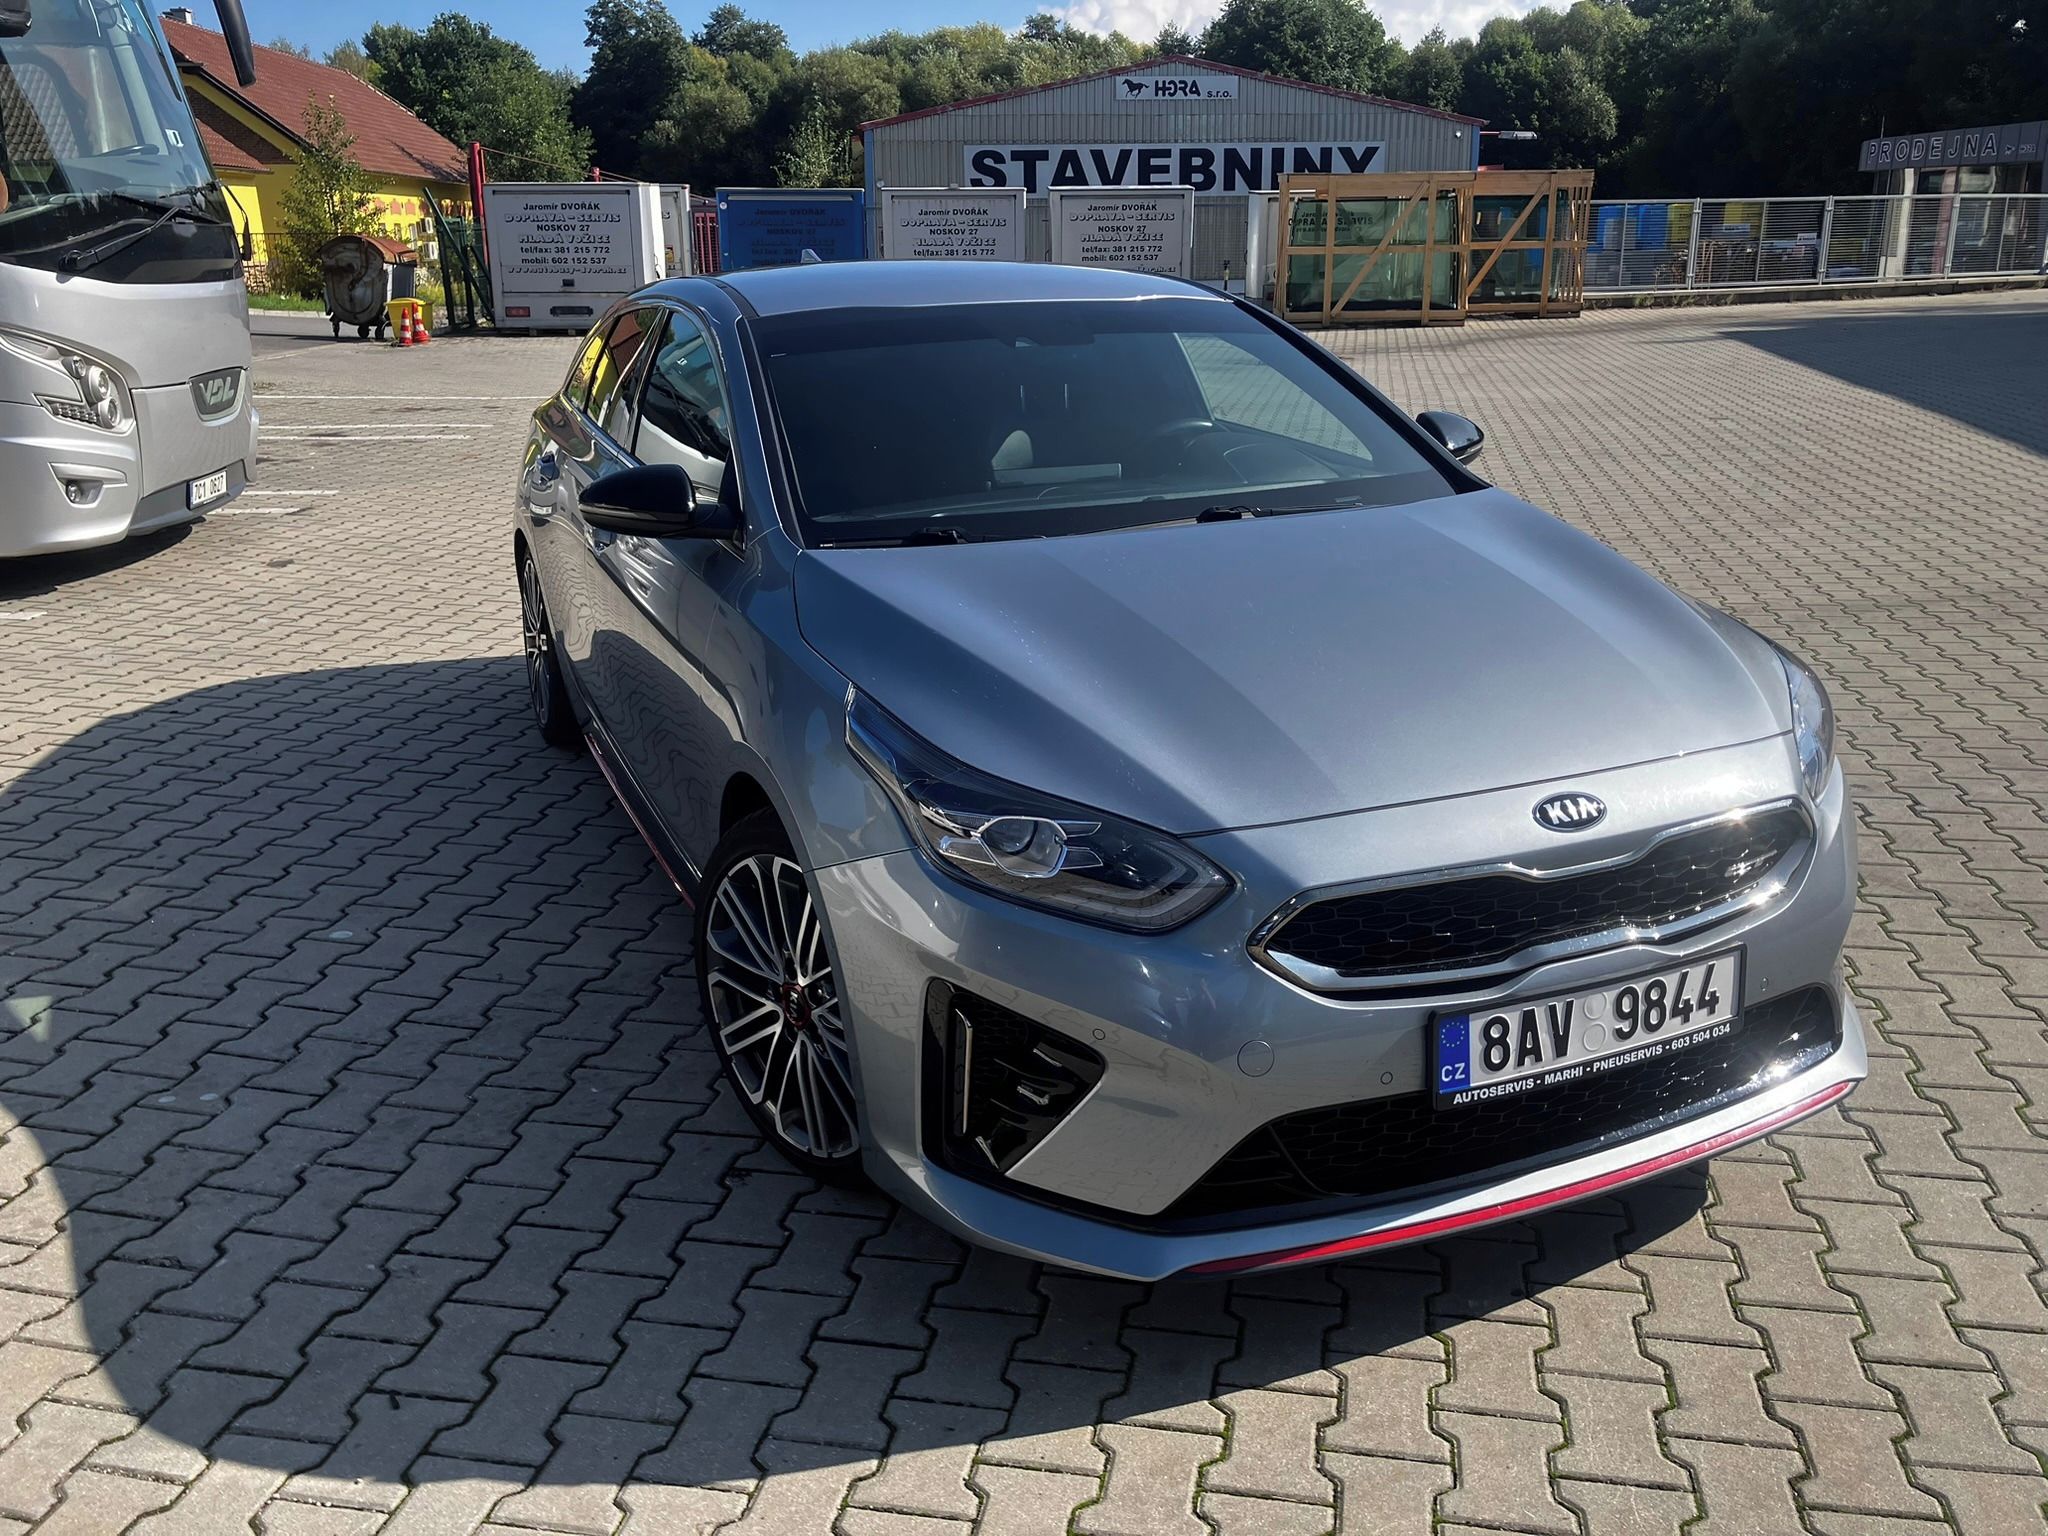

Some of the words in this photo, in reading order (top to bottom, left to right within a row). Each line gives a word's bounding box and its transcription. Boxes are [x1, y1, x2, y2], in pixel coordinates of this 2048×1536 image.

[1155, 79, 1201, 97] HORA
[1207, 90, 1232, 98] s.r.o.
[1868, 133, 1997, 164] PRODEJNA
[969, 146, 1380, 191] STAVEBNINY
[523, 203, 558, 211] Jaromír
[560, 202, 600, 211] DVOŘÁK
[918, 208, 951, 216] Jaromír
[952, 207, 989, 216] DVOŘÁK
[1088, 203, 1120, 212] Jaromír
[1121, 201, 1157, 211] DVOŘÁK
[504, 213, 567, 223] DOPRAVA
[577, 213, 621, 223] SERVIS
[901, 218, 957, 227] DOPRAVA
[967, 217, 1007, 227] SERVIS
[1069, 213, 1126, 222] DOPRAVA
[1135, 212, 1176, 222] SERVIS
[537, 224, 577, 232] NOSKOV
[580, 224, 590, 232] 27
[929, 228, 966, 236] NOSKOV
[968, 228, 978, 236] 27
[1098, 225, 1134, 233] NOSKOV
[1136, 225, 1147, 233] 27
[520, 232, 565, 244] MLADÁ
[567, 232, 611, 244] VOŽICE
[957, 237, 997, 247] VOŽICE
[1081, 231, 1122, 243] MLADÁ
[1125, 231, 1164, 242] VOŽICE
[520, 246, 552, 254] tel/fax:
[554, 246, 571, 254] 381
[574, 246, 591, 254] 215
[594, 246, 610, 254] 772
[914, 249, 942, 257] tel/fax:
[944, 249, 959, 257] 381
[1082, 246, 1111, 254] tel/fax:
[1147, 245, 1163, 253] 772
[521, 257, 549, 265] mobil:
[551, 257, 569, 265] 602
[571, 257, 588, 265] 152
[590, 257, 607, 265] 537
[1081, 255, 1107, 263] mobil:
[1108, 254, 1125, 262] 602
[1127, 254, 1142, 262] 152
[1143, 254, 1159, 262] 537
[199, 376, 235, 406] VDL
[194, 480, 206, 499] 7C1
[1543, 796, 1600, 825] KIA
[1482, 998, 1575, 1072] 8AV
[1614, 961, 1721, 1041] 9844
[1453, 1077, 1534, 1105] AUTOSERVIS
[1544, 1066, 1583, 1085] MARHI
[1593, 1044, 1663, 1072] PNEUSERVIS
[1671, 1036, 1690, 1050] 603
[1692, 1031, 1711, 1045] 504
[1712, 1025, 1731, 1039] 034
[1441, 1062, 1465, 1083] CZ
